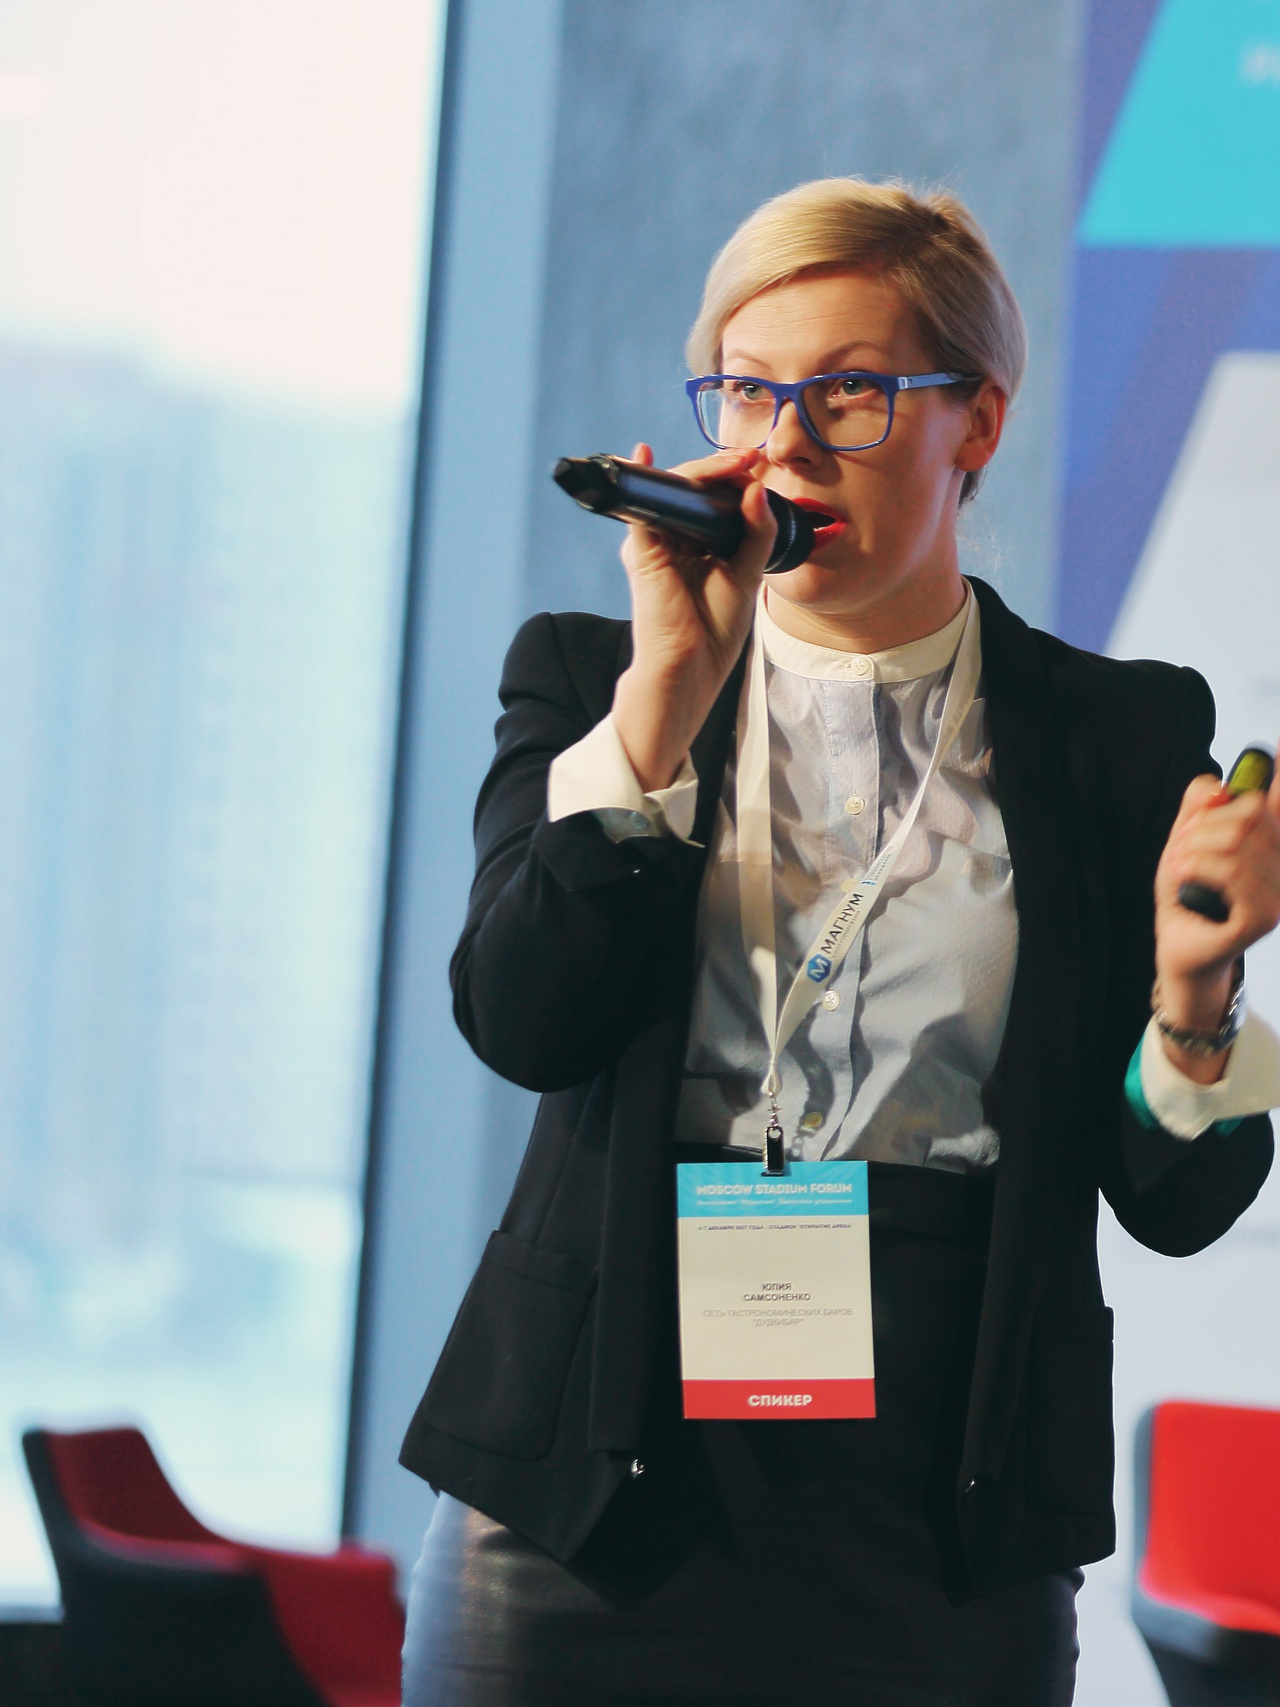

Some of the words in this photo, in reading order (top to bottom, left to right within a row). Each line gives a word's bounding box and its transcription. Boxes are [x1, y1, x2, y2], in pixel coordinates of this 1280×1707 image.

[821, 893, 864, 955] МАГНУМ
[696, 1185, 753, 1196] MOSCOW
[755, 1184, 808, 1195] STADIUM
[810, 1183, 853, 1194] FORUM
[762, 1283, 792, 1291] ЮЛИЯ
[743, 1292, 812, 1302] САМСОНЕНКО
[703, 1309, 726, 1318] СЕТЬ
[728, 1308, 821, 1317] ГАСТРОНОМИЧЕСКИХ
[824, 1308, 853, 1316] БАРОВ
[748, 1394, 813, 1407] СПИКЕР
